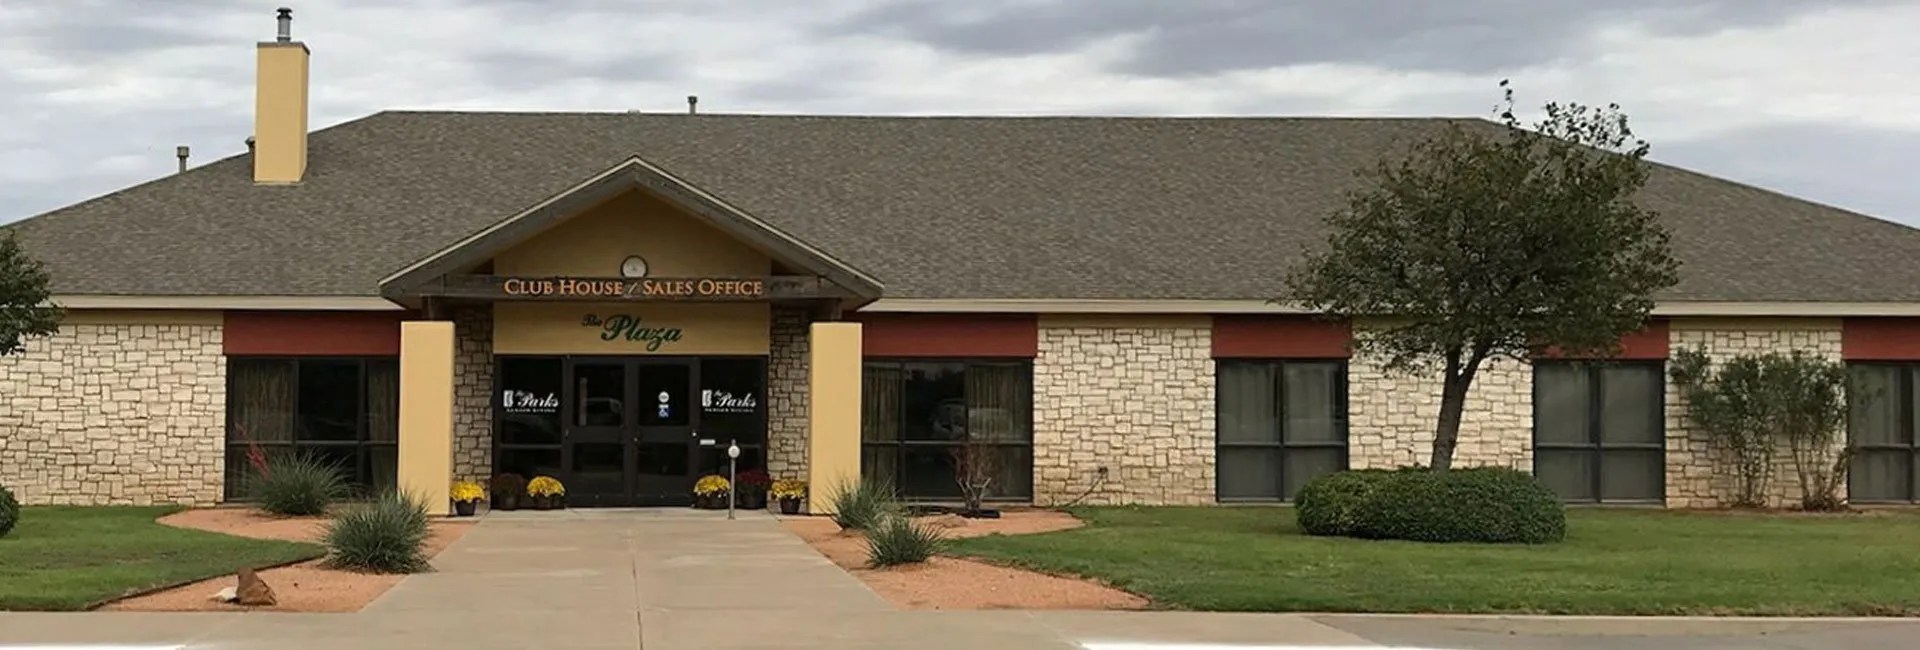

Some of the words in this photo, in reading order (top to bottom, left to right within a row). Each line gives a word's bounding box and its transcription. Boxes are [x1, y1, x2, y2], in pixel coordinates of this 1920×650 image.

[504, 279, 554, 295] CLUB
[559, 279, 624, 295] HOUSE
[642, 279, 694, 295] SALES
[698, 279, 762, 295] OFFICE
[601, 313, 683, 352] Plaza
